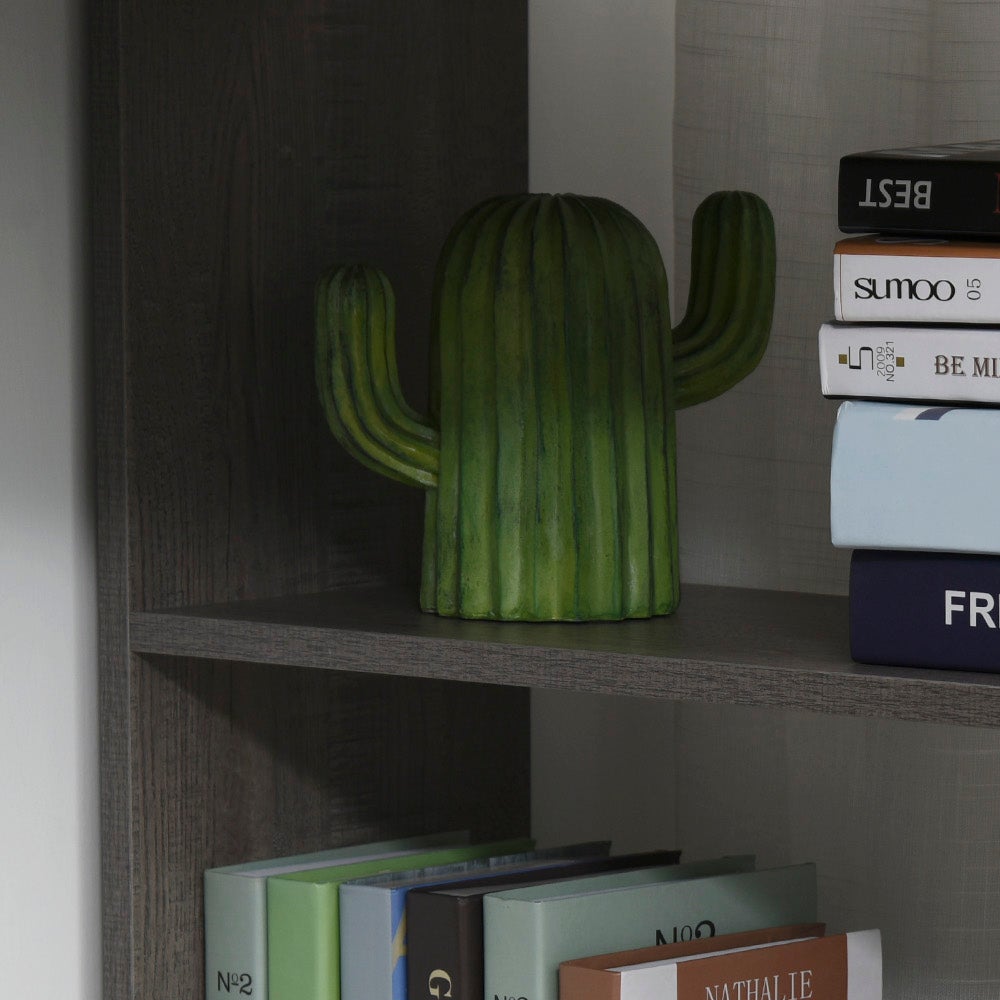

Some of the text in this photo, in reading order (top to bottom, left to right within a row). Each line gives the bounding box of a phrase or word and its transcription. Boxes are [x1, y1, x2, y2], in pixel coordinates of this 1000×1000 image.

[859, 179, 931, 209] BEST
[854, 277, 956, 302] sumoo
[966, 278, 982, 301] 05
[934, 355, 965, 376] BE
